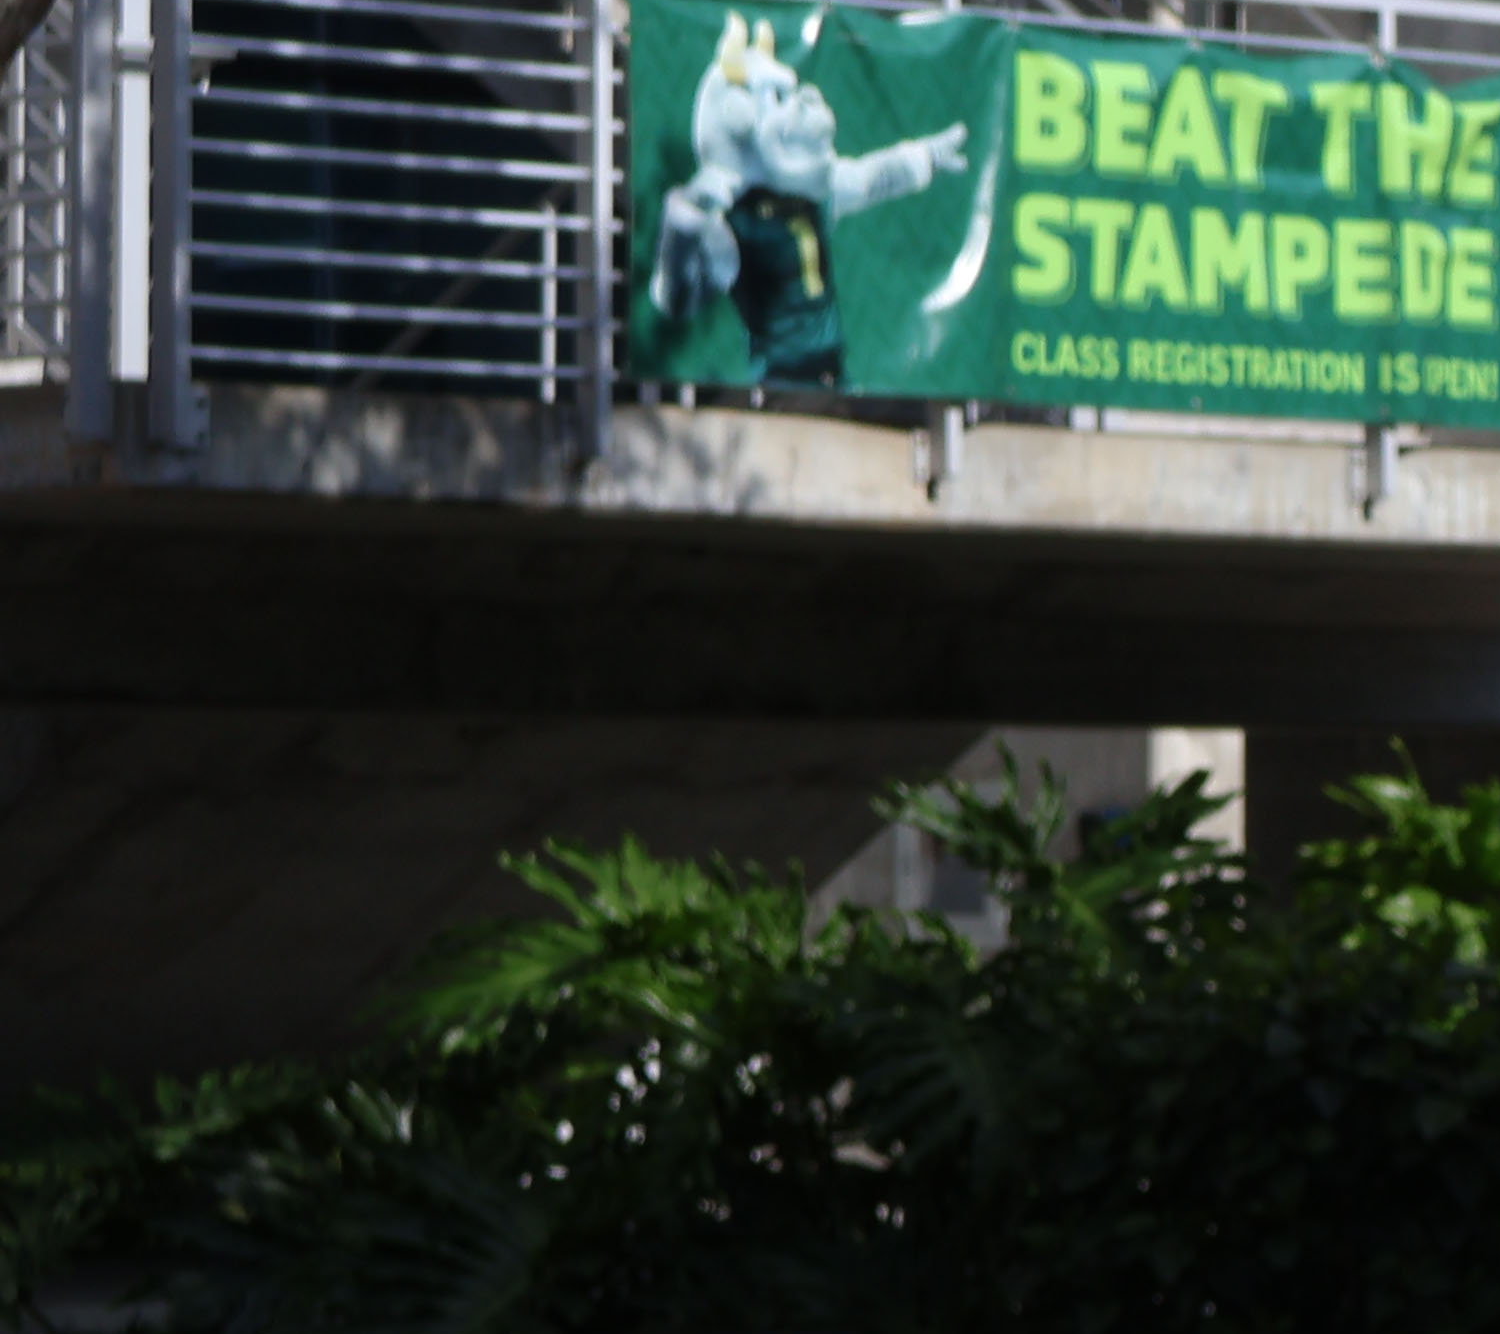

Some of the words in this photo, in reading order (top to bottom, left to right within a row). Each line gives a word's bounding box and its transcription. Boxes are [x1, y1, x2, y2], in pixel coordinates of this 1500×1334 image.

[1012, 49, 1287, 186] BEAT
[1012, 191, 1497, 328] STAMPEDE
[1013, 332, 1120, 381] CLASS
[1127, 338, 1366, 395] REGISTRATION
